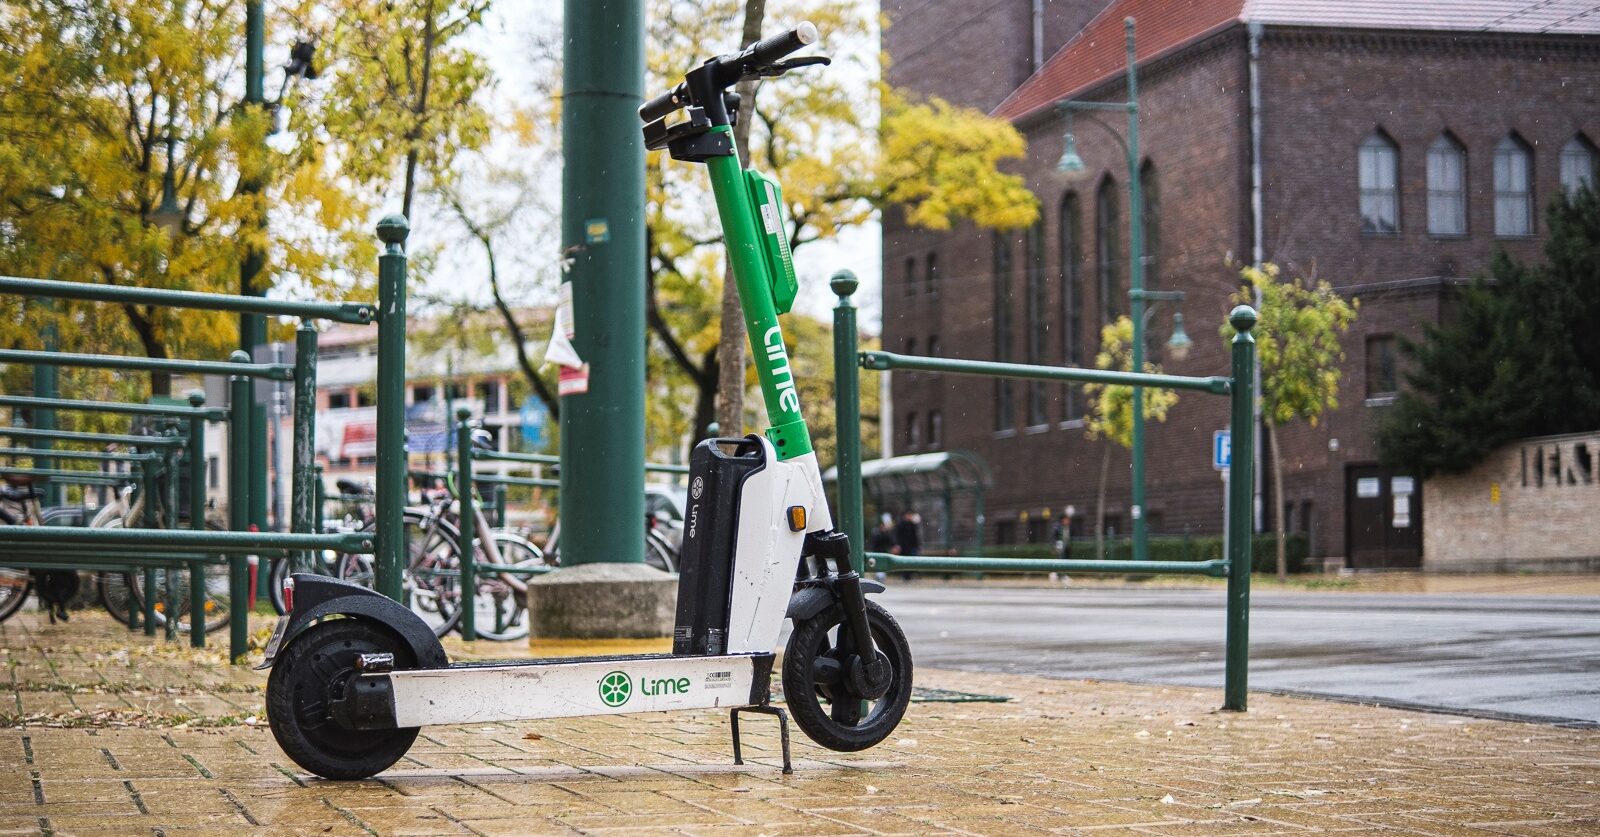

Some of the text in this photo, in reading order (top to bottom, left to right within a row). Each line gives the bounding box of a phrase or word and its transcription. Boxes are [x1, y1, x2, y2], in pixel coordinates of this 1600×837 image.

[764, 326, 799, 413] Lime
[689, 504, 699, 538] Lime
[641, 677, 691, 696] Lime
